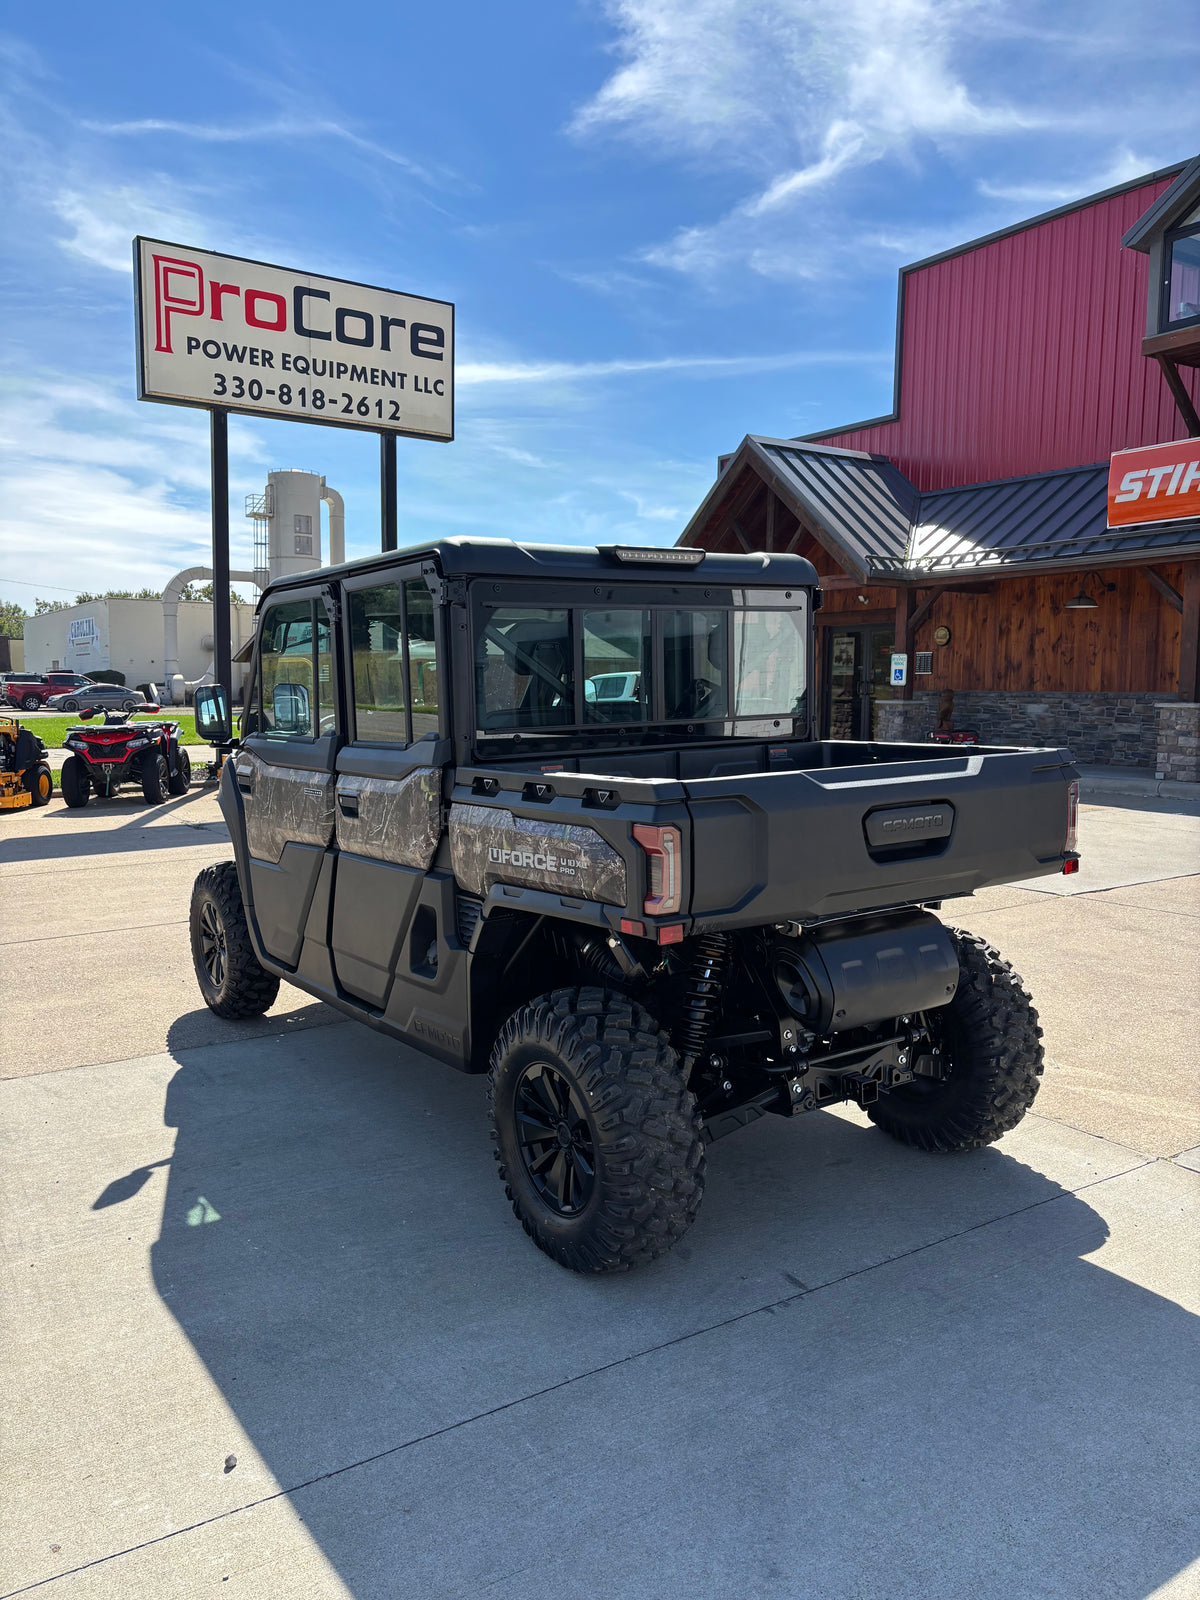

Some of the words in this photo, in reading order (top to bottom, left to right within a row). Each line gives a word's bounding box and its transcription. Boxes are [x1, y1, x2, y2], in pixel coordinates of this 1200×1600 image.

[152, 254, 445, 361] ProCore
[187, 336, 275, 369] POWER
[281, 352, 408, 390] EQUIPMENT
[414, 375, 445, 396] LLC
[213, 373, 401, 421] 330-818-2612
[488, 847, 558, 872] UFORCE
[560, 866, 575, 875] PRO
